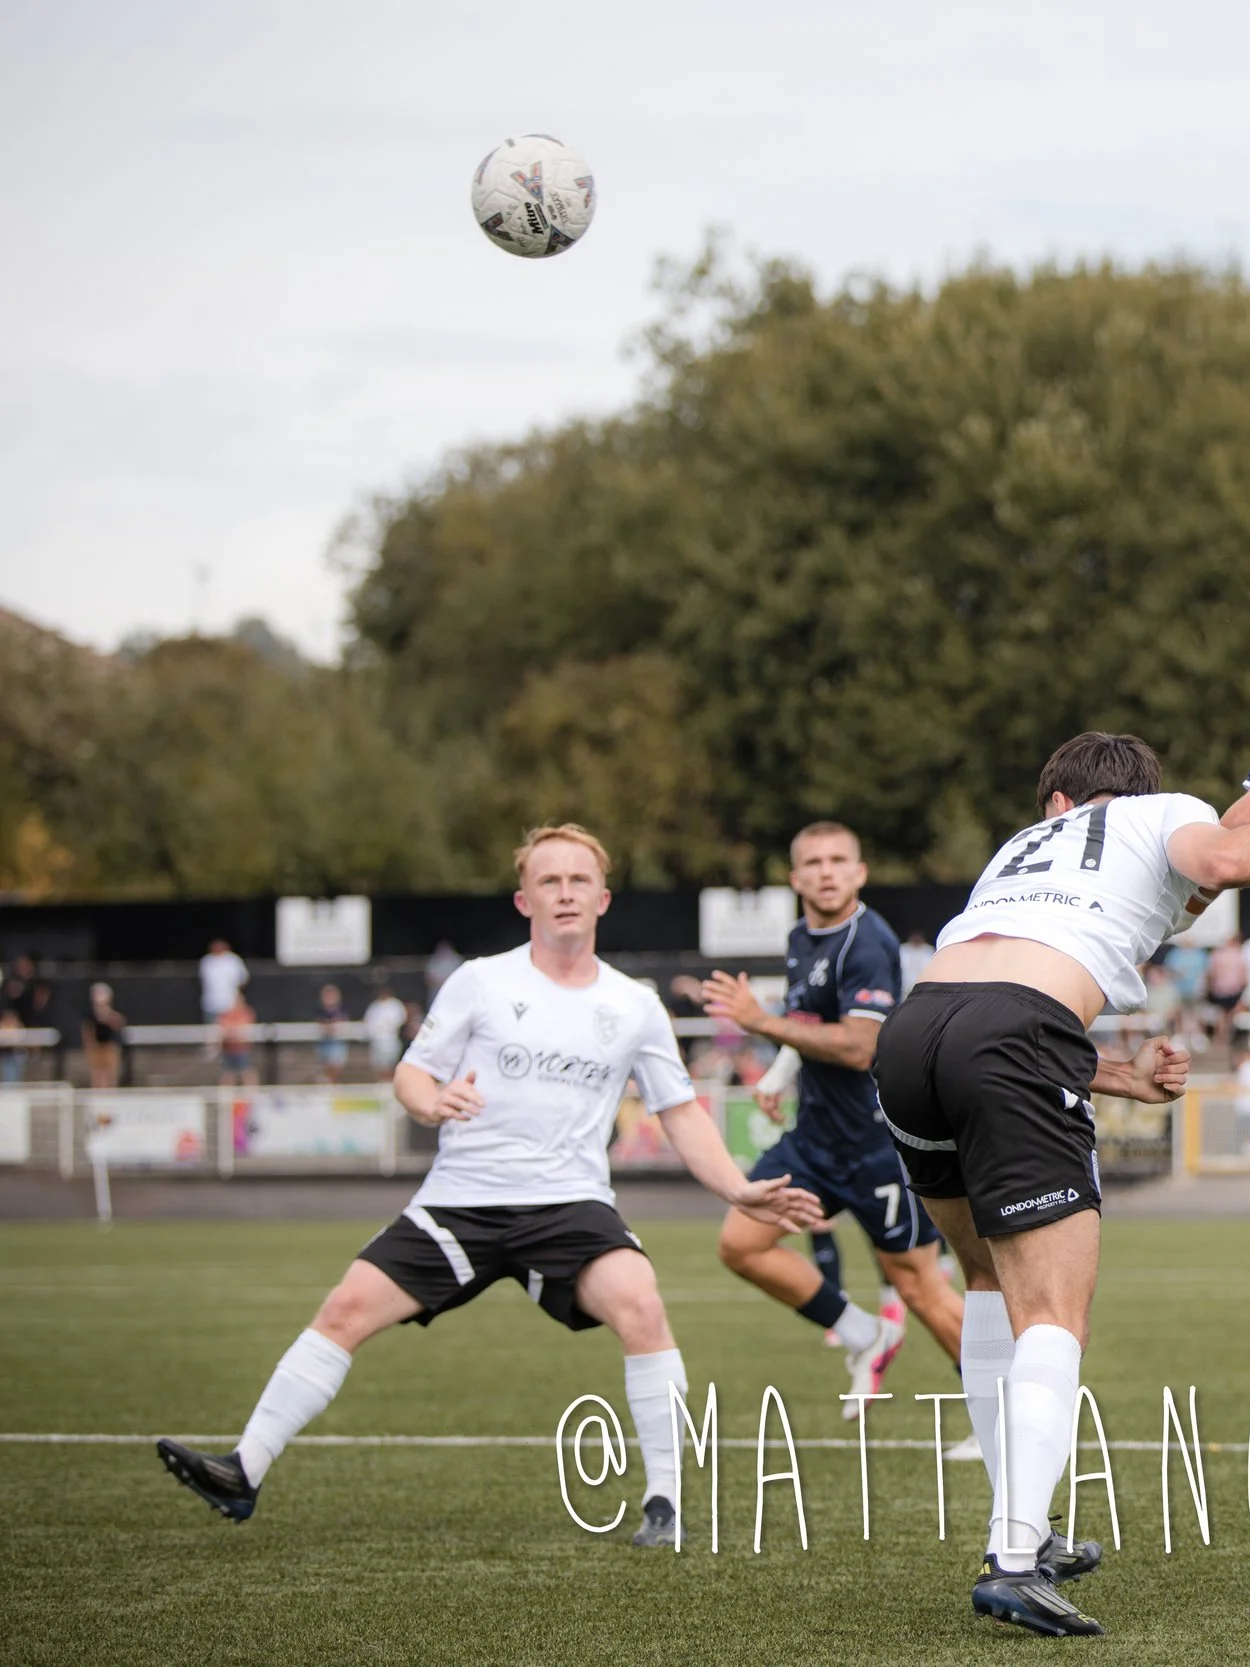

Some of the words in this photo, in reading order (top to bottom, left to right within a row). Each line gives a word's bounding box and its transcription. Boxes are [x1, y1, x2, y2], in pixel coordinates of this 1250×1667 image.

[996, 801, 1110, 878] 21
[874, 1182, 901, 1229] 7
[1000, 1189, 1066, 1216] LONDONMETRIC
